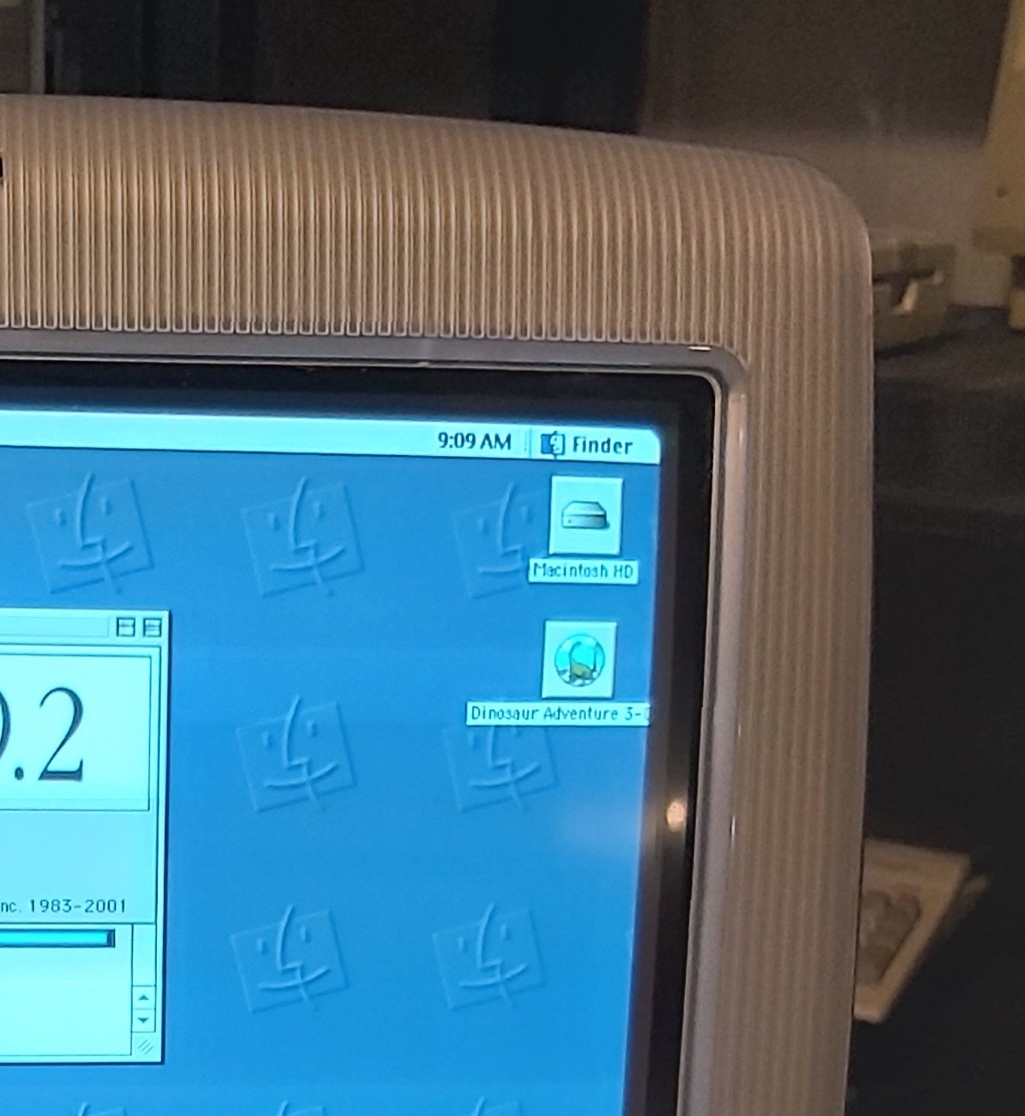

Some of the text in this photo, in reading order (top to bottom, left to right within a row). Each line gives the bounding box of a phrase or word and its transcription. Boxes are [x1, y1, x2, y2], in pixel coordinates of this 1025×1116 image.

[437, 431, 512, 451] 9:09 AM
[572, 435, 634, 455] Finder
[532, 561, 634, 579] Macintosh HD
[470, 704, 540, 721] Dinosaur
[543, 706, 619, 721] Adventure
[30, 898, 125, 914] 1983-2001
